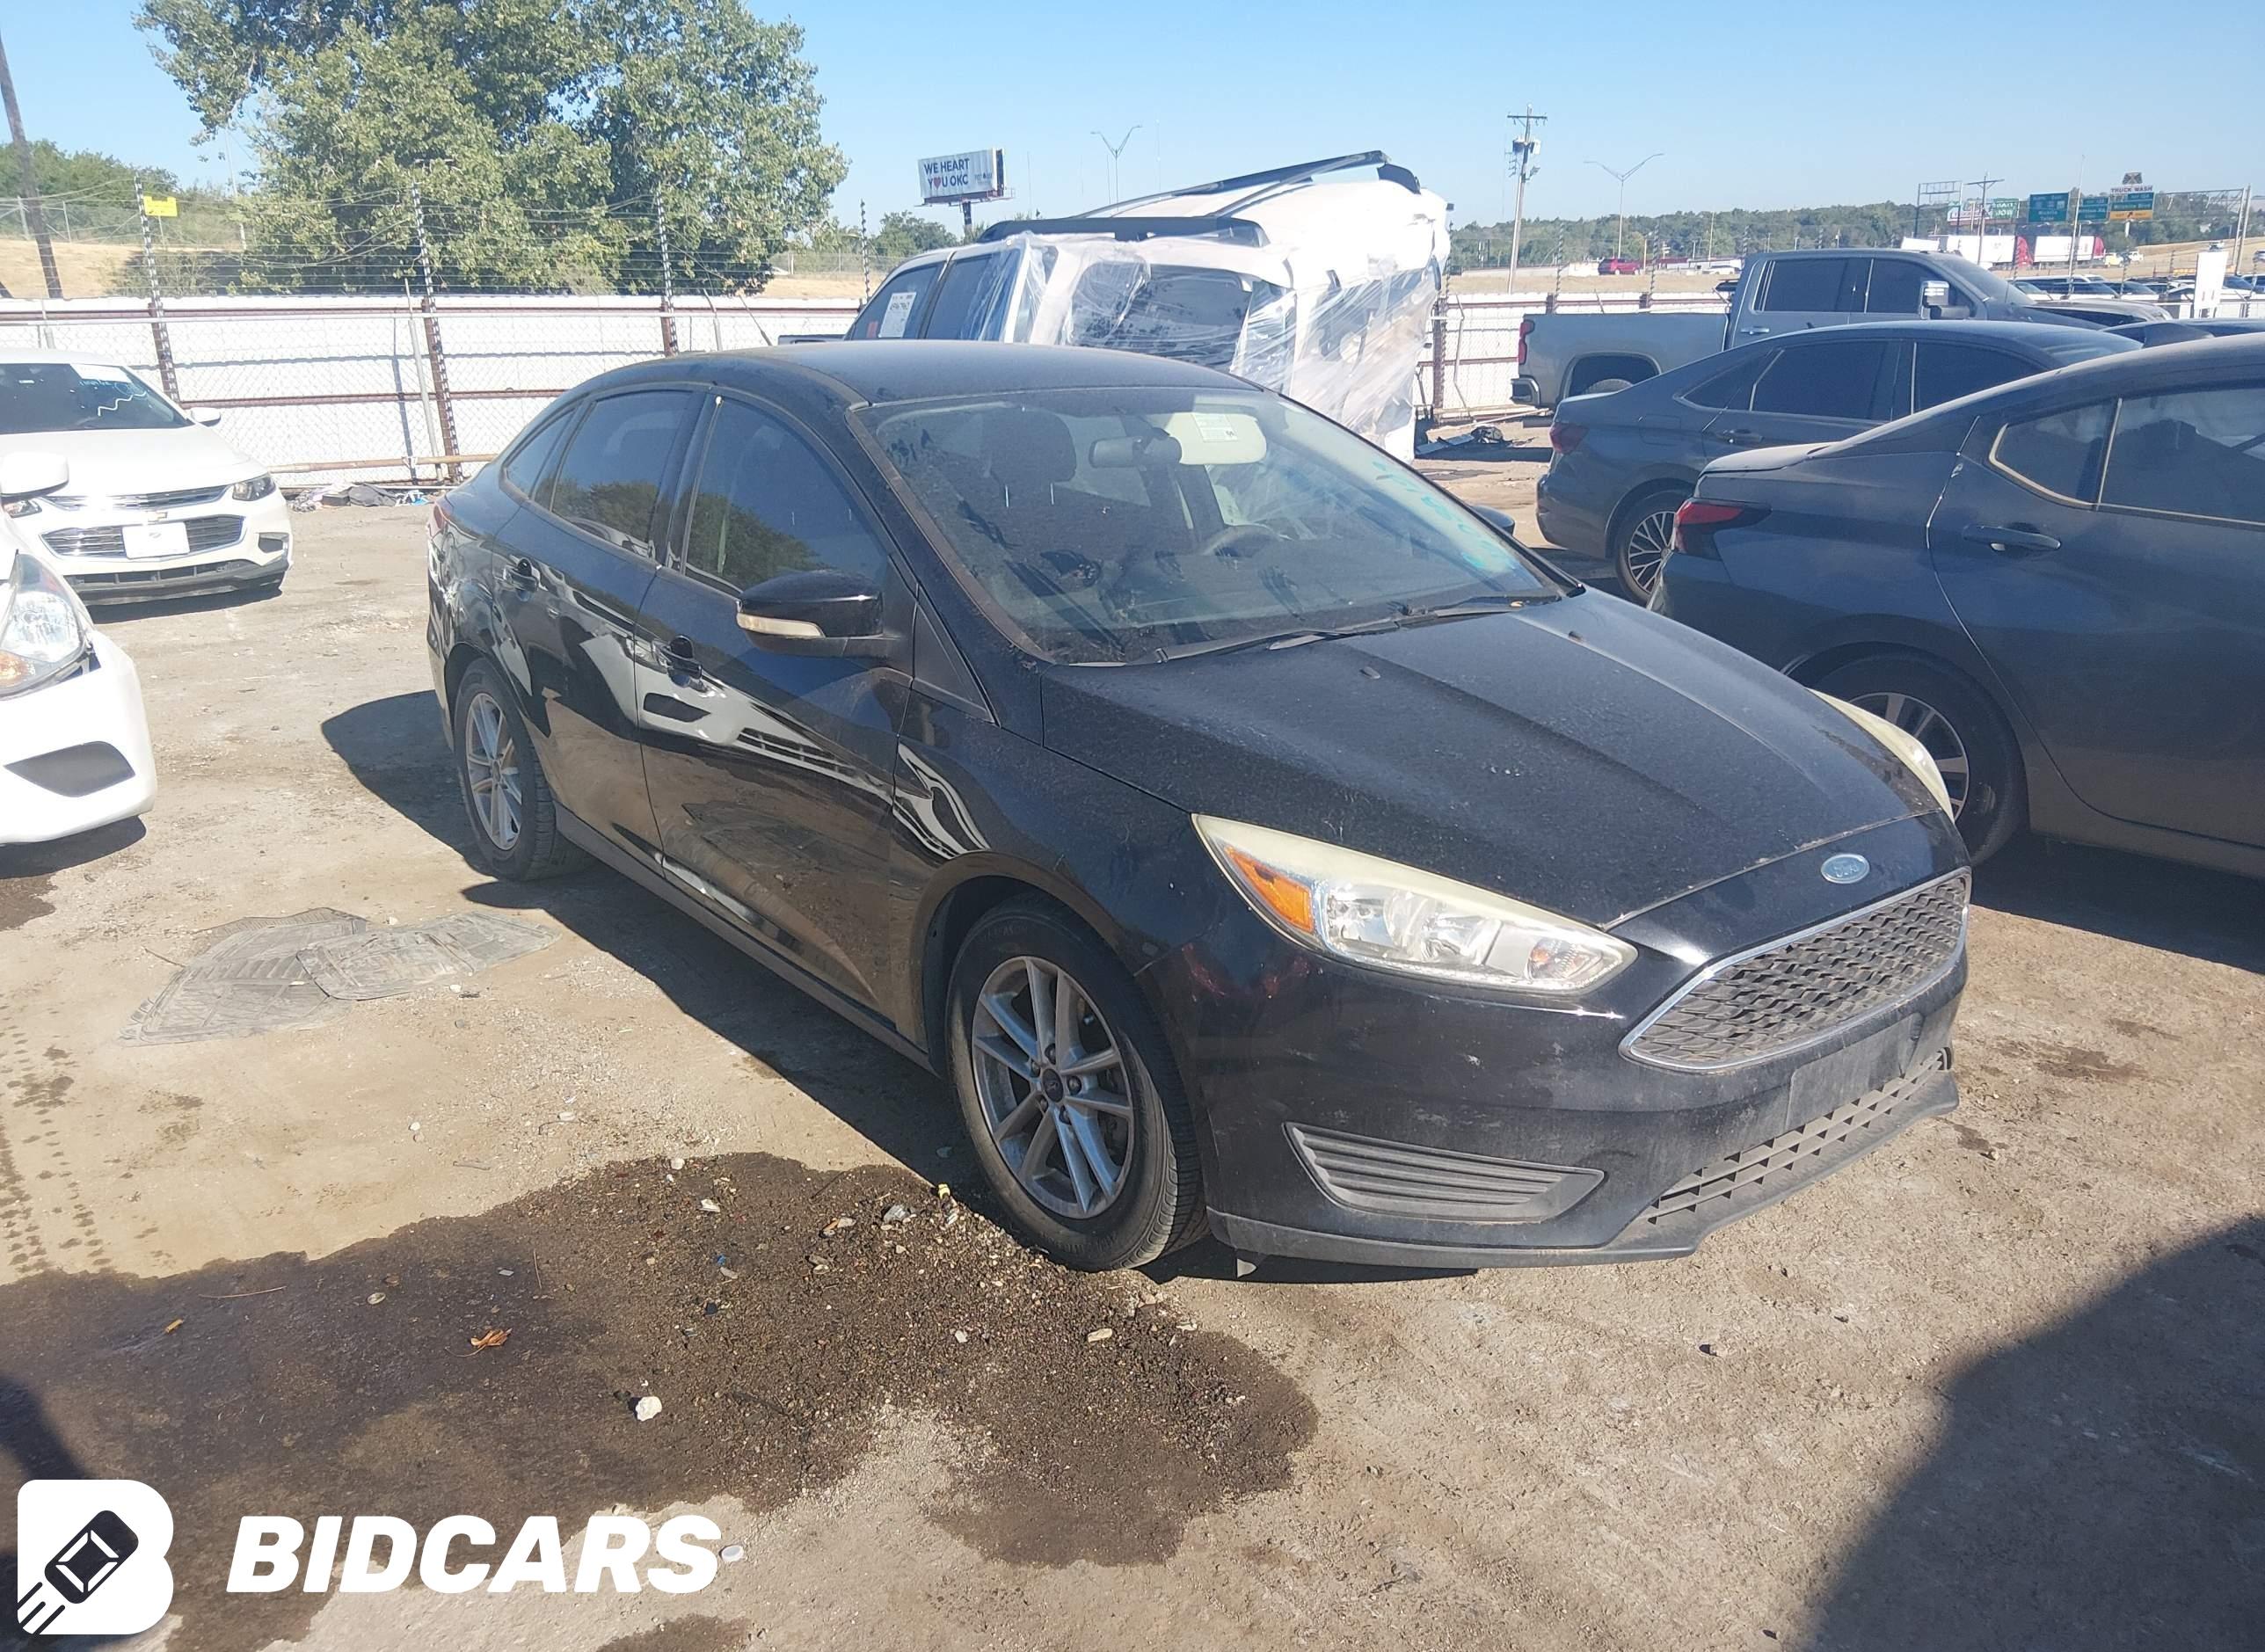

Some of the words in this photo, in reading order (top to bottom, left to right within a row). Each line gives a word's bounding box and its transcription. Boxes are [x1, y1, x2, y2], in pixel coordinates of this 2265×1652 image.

[923, 163, 938, 175] WE
[940, 158, 970, 173] HEART
[950, 174, 969, 186] OKC
